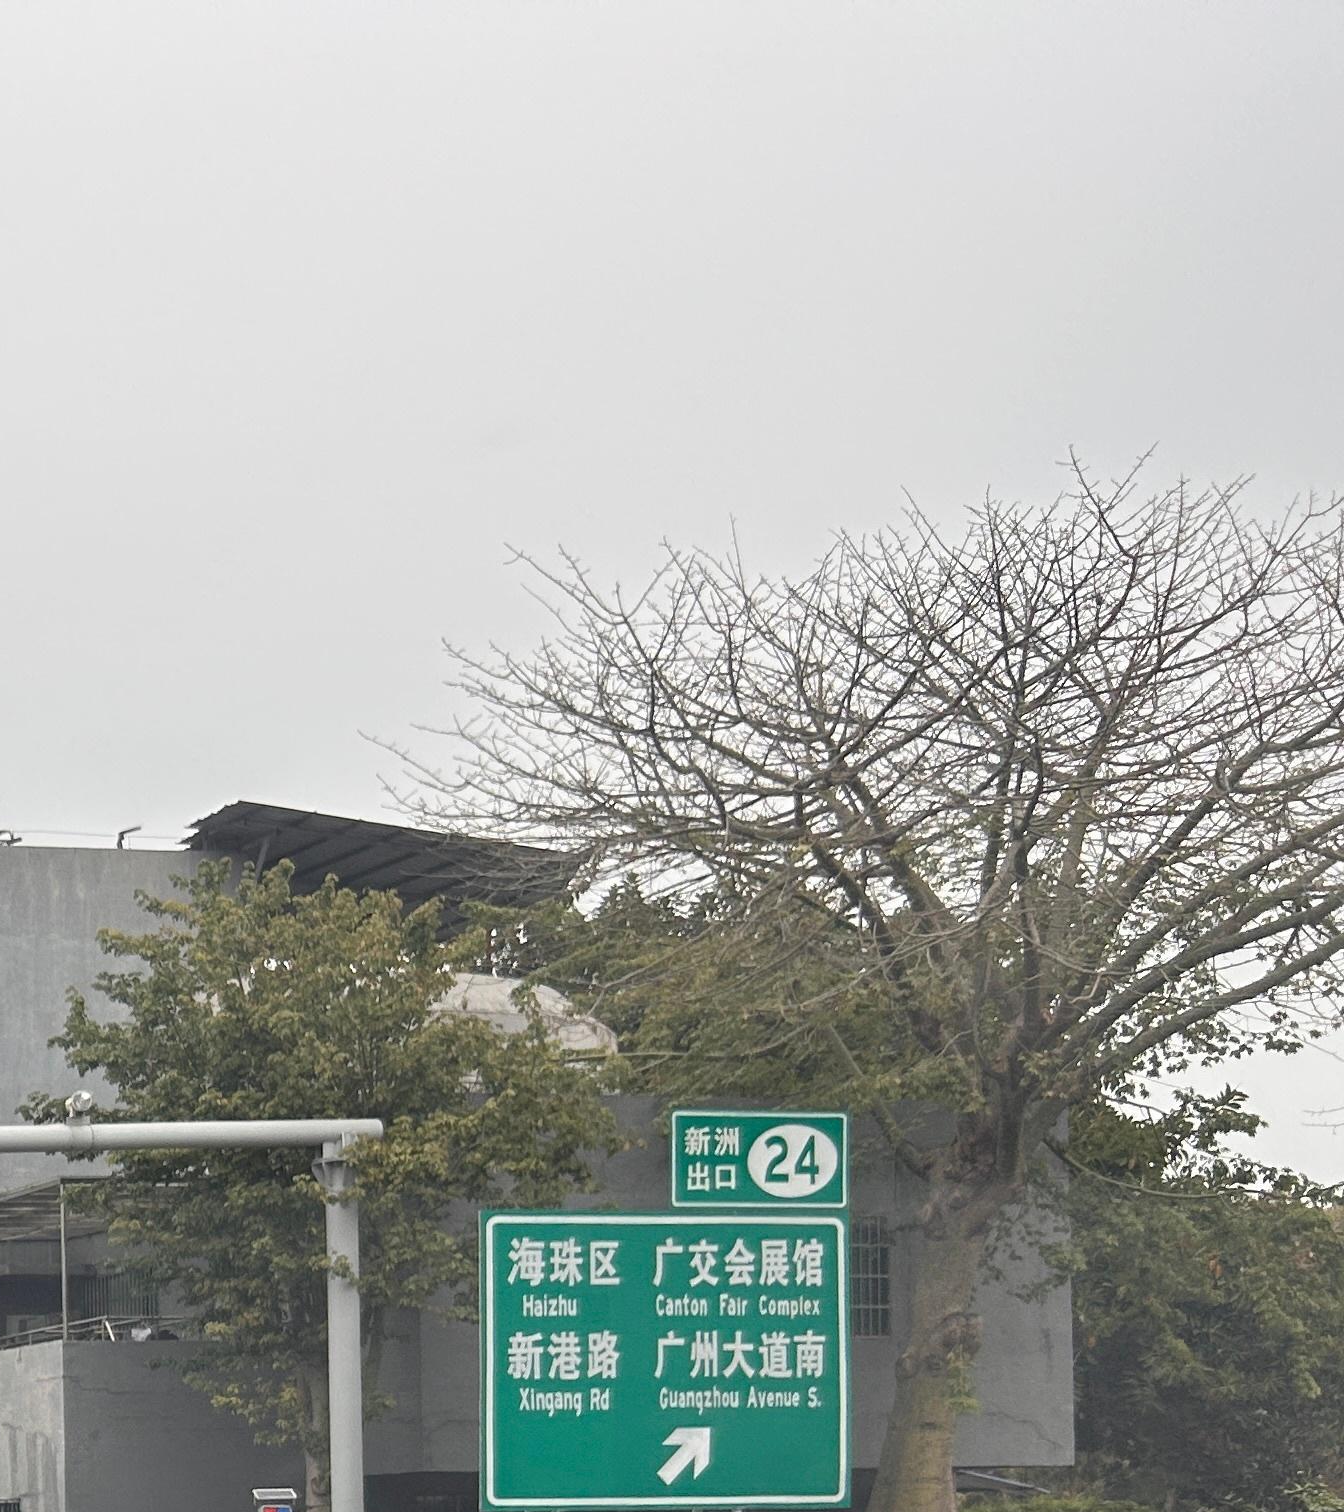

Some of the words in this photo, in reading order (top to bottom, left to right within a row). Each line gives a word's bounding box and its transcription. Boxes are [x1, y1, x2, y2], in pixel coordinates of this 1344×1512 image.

[684, 1127, 740, 1156] 新洲
[764, 1135, 819, 1185] 24
[686, 1163, 737, 1192] 出口
[507, 1237, 620, 1287] 海珠区
[652, 1238, 824, 1287] 广交会展馆
[522, 1295, 577, 1317] Haizhu
[656, 1295, 707, 1316] Canton
[719, 1294, 748, 1316] Fair
[759, 1295, 820, 1320] Complex
[507, 1331, 620, 1379] 新港路
[654, 1331, 826, 1379] 广州大道南
[519, 1389, 582, 1417] Xingang
[590, 1389, 609, 1411] Rd
[659, 1387, 739, 1414] Guangzhou
[747, 1387, 800, 1407] Avenue
[807, 1387, 821, 1407] S.
